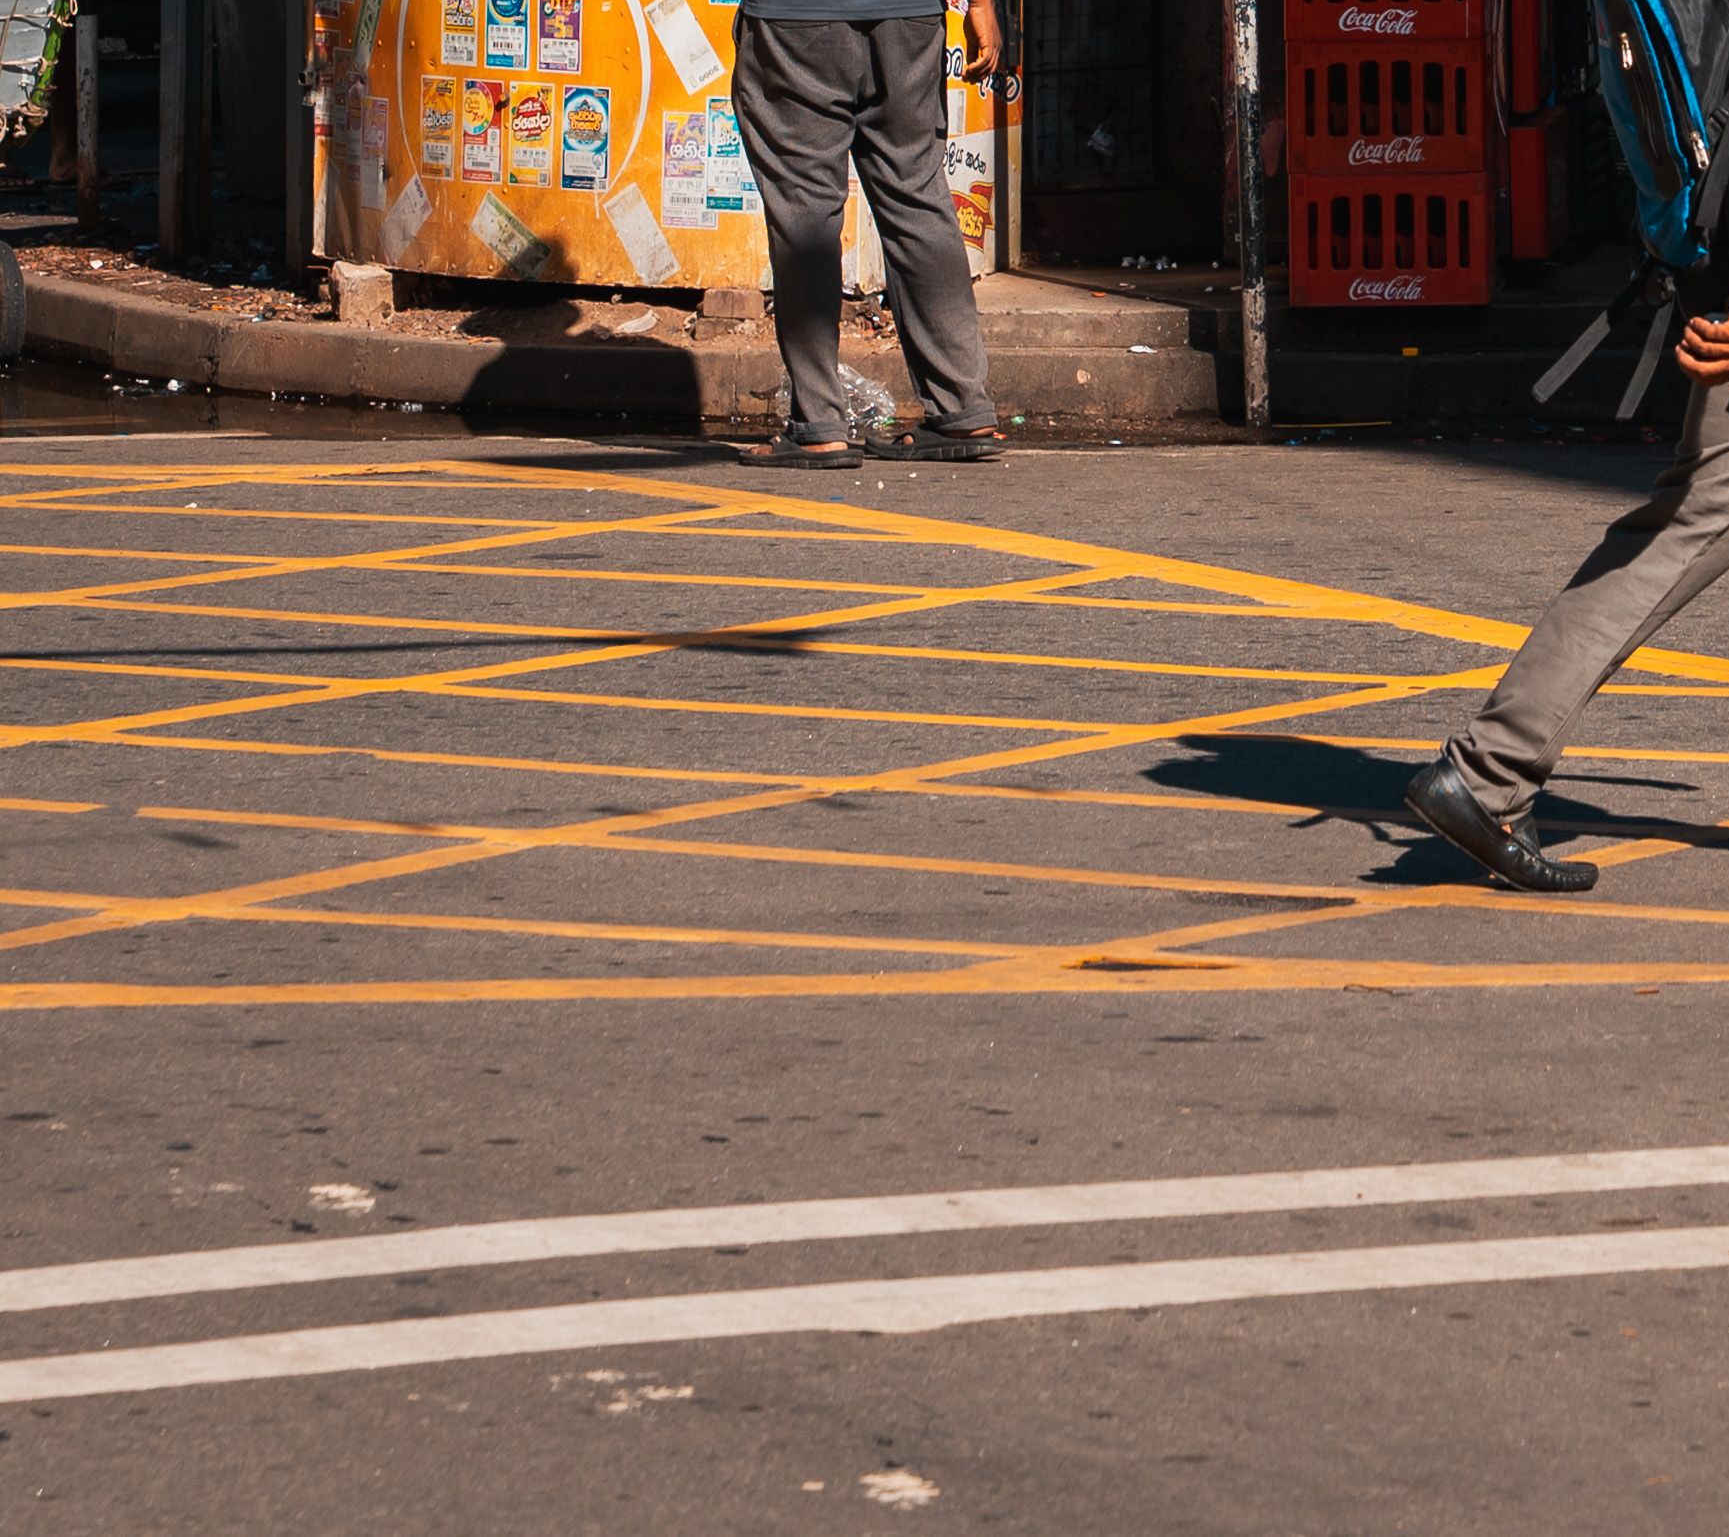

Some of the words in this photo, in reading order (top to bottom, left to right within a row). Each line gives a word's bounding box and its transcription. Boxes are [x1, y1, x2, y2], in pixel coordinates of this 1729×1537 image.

[1338, 6, 1417, 35] Coca-Cola
[1349, 136, 1425, 165] Coca-Cola
[1349, 275, 1426, 301] Coca-Cola
